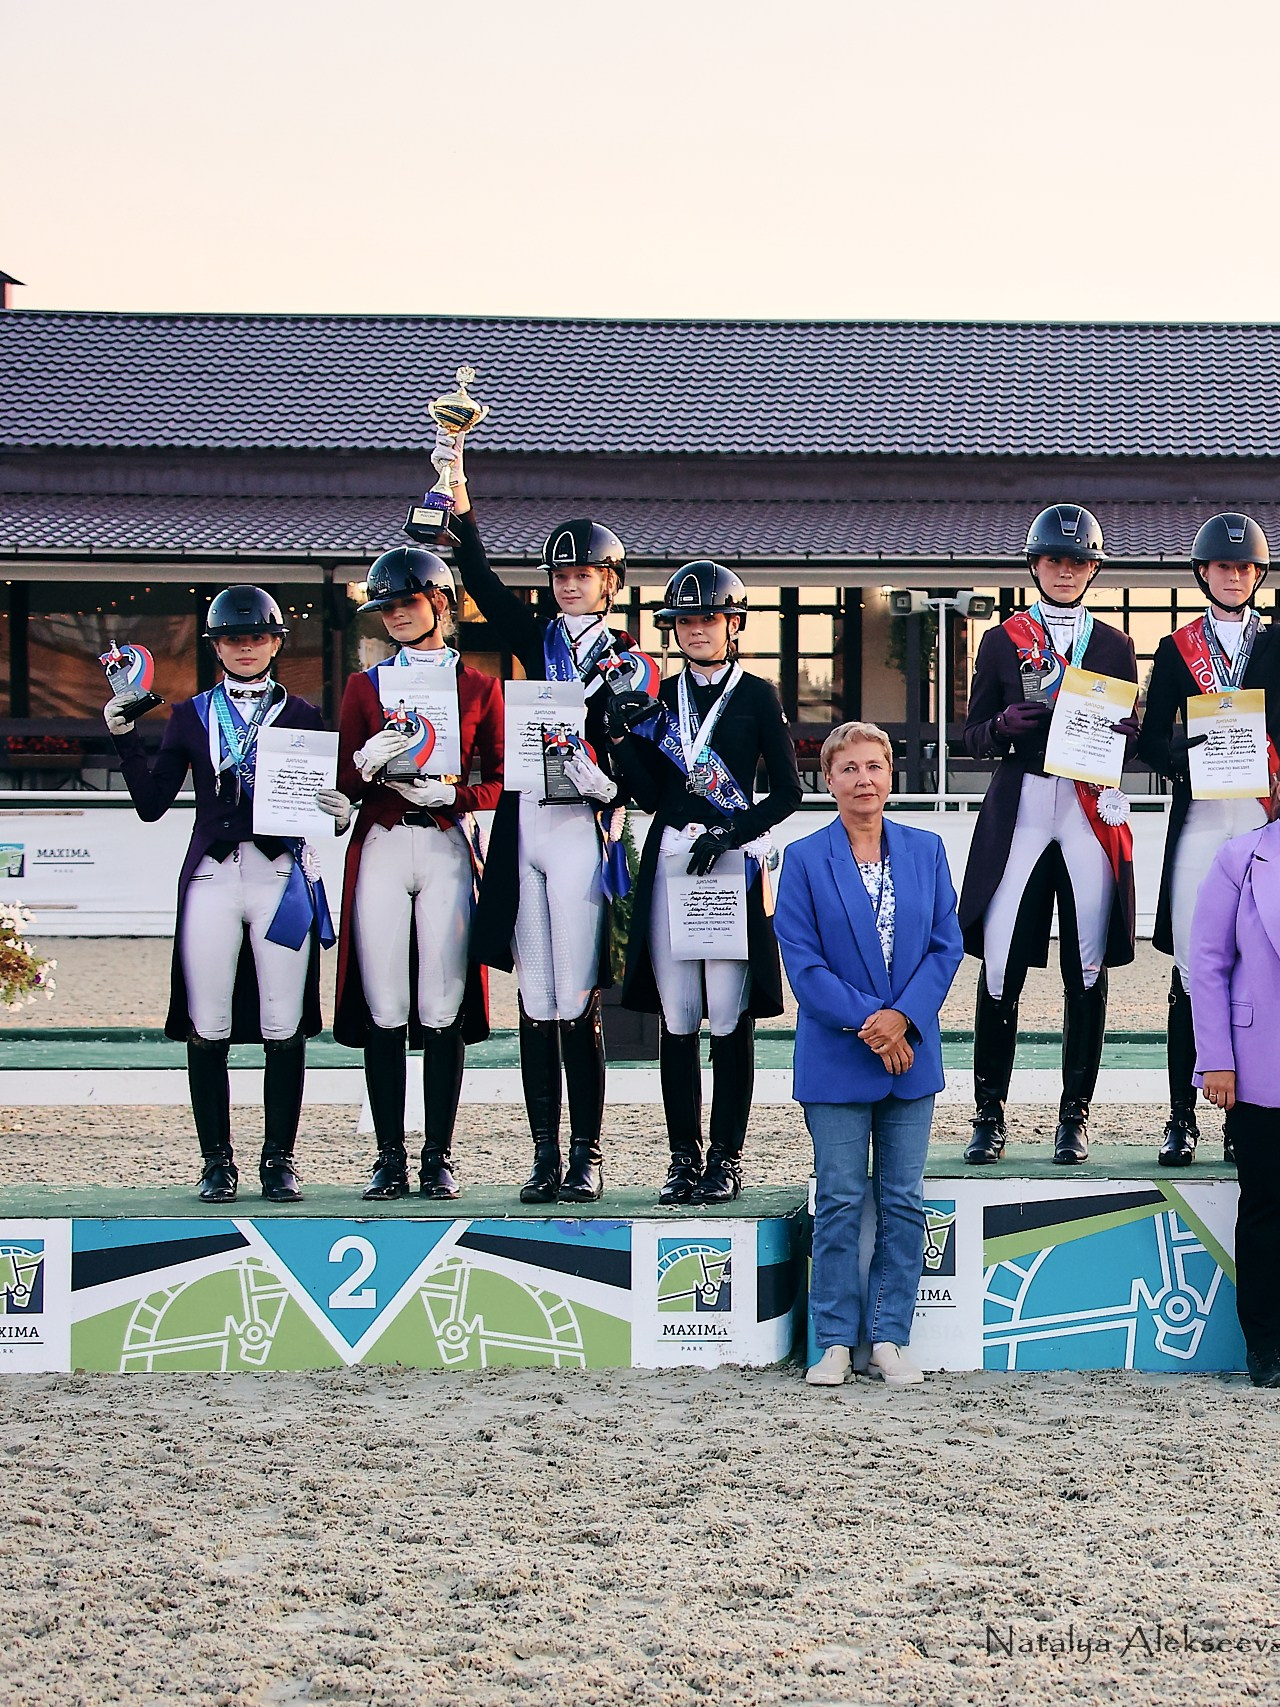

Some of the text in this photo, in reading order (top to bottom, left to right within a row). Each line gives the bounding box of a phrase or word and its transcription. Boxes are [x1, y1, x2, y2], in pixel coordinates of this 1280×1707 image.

[36, 848, 91, 858] MAXIMA
[328, 1235, 377, 1309] 2
[916, 1289, 952, 1301] IMA
[0, 1326, 40, 1338] XIMA
[662, 1324, 728, 1336] MAXIMA
